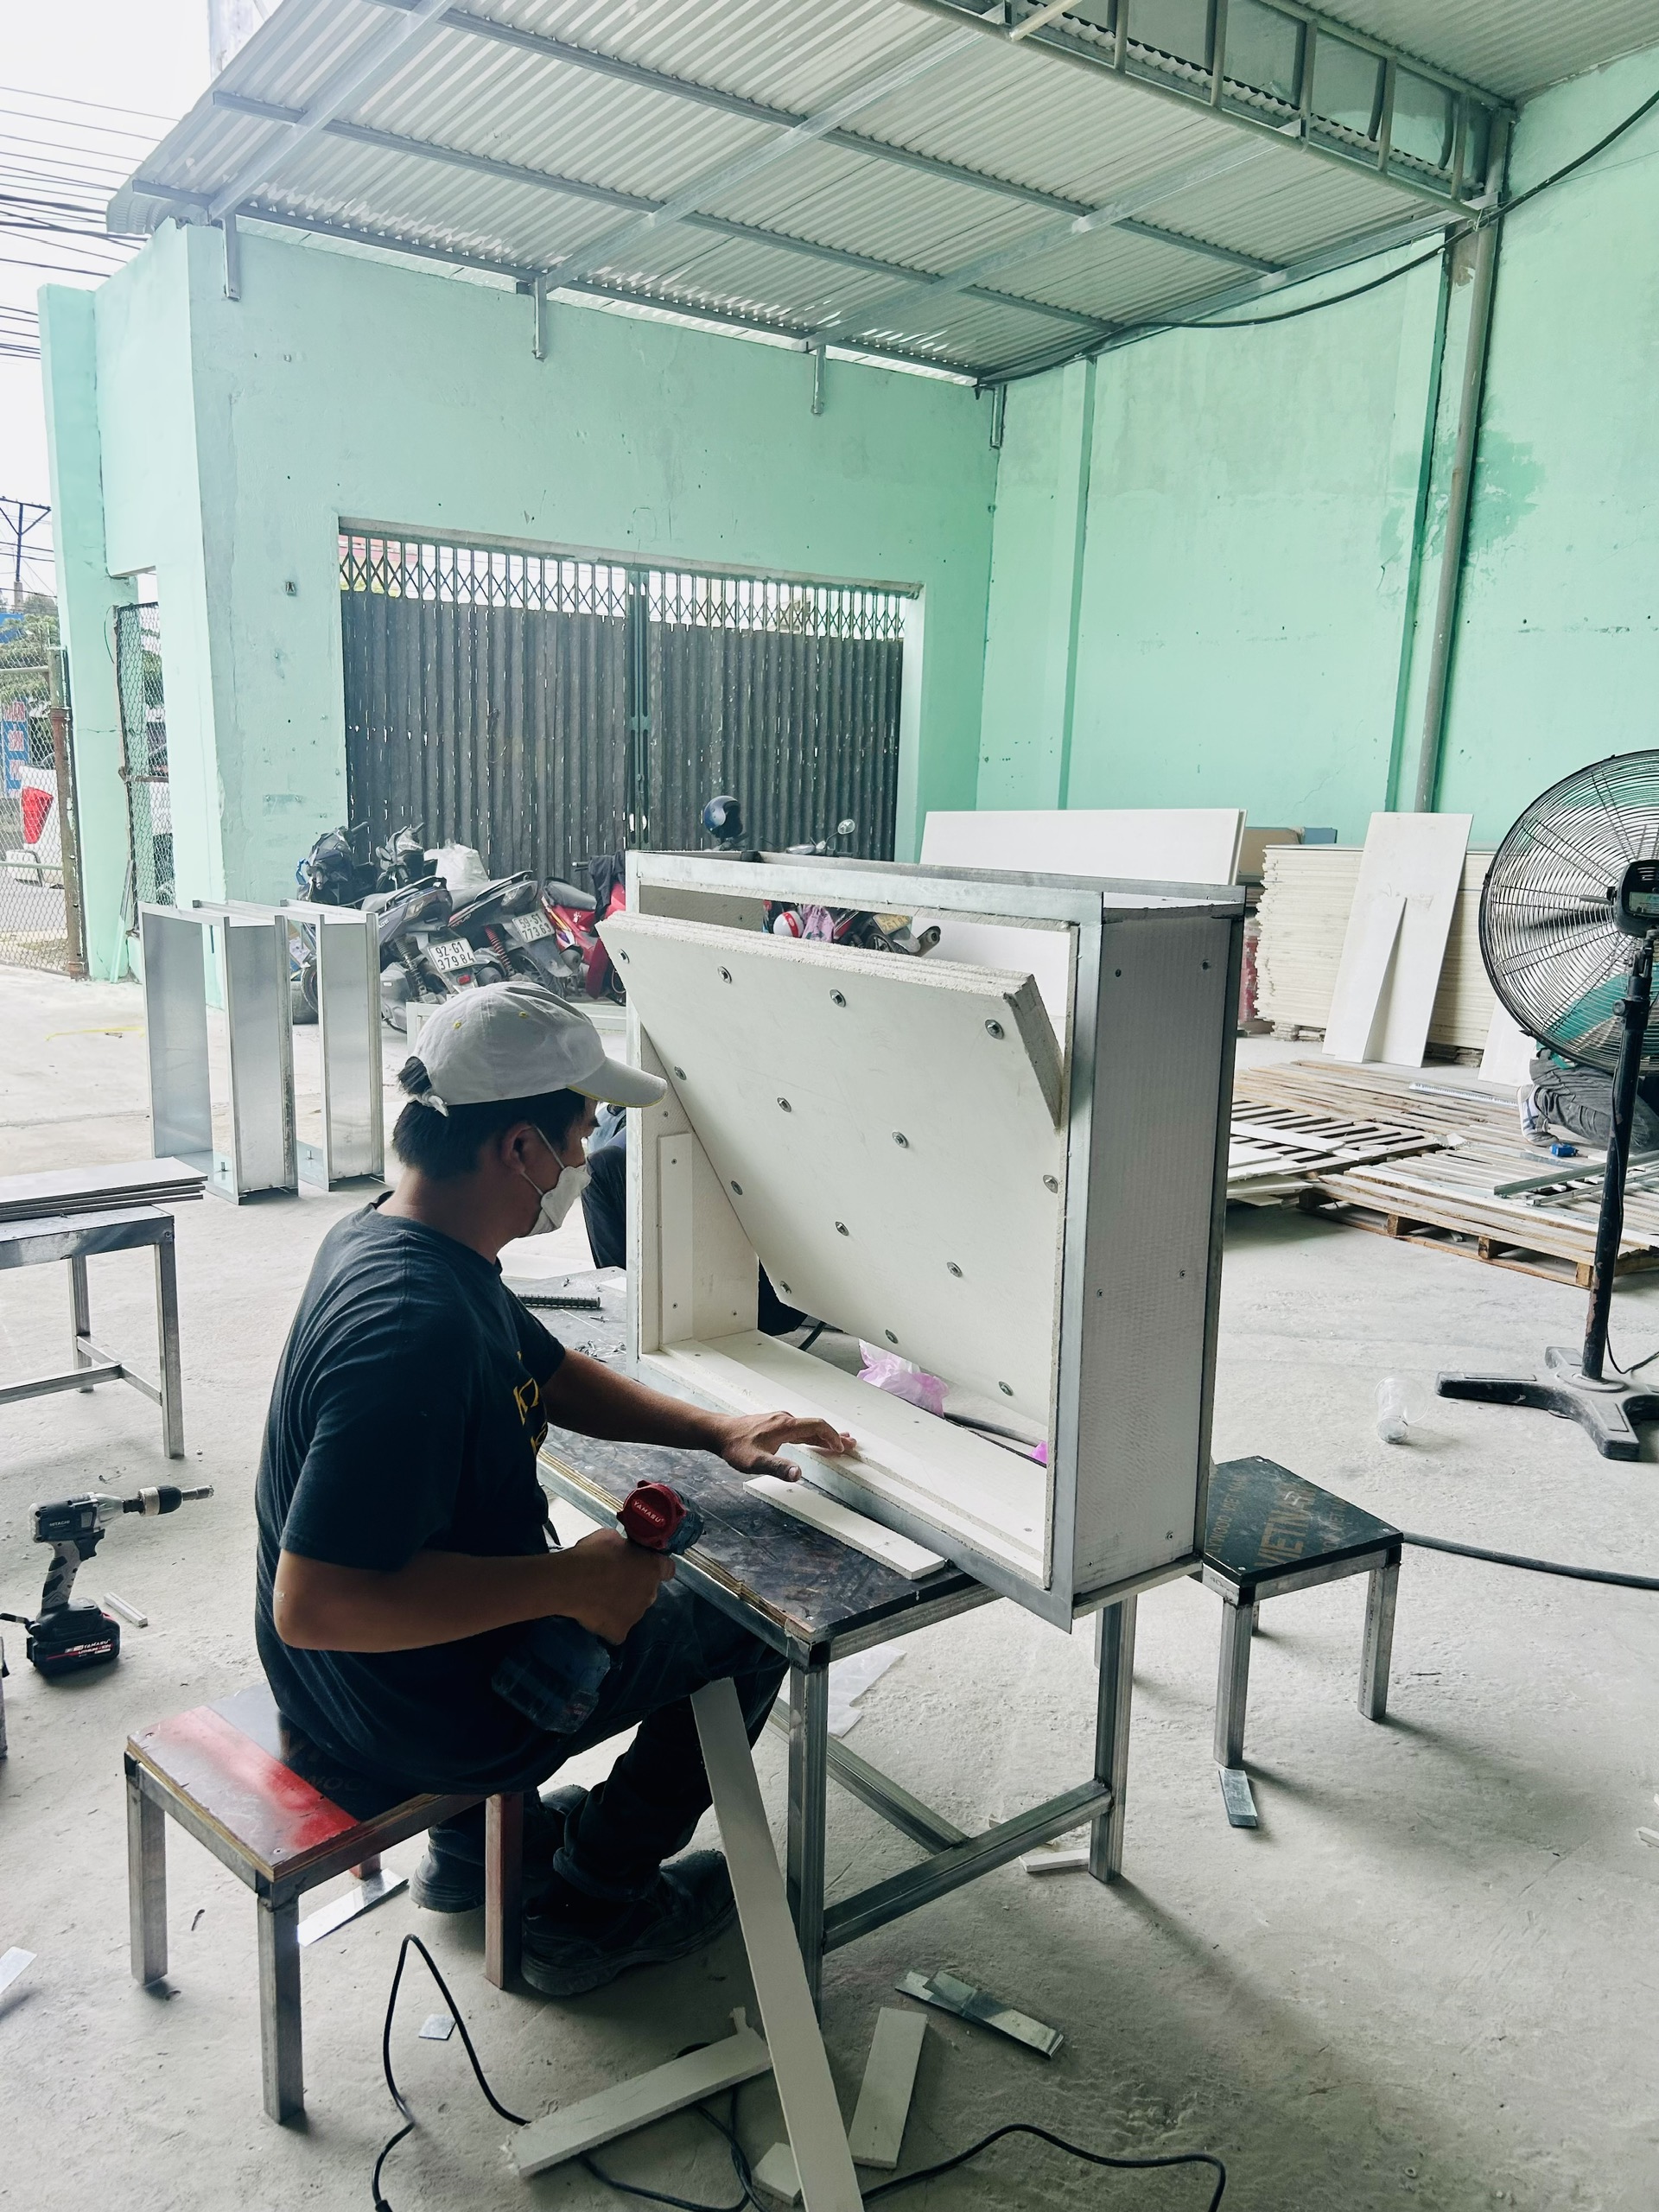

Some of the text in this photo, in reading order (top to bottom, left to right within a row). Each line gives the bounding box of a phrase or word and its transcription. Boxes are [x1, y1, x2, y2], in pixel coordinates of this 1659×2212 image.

[518, 913, 543, 929] 59-S1
[522, 922, 552, 941] 773.63
[435, 941, 465, 957] 92-G1
[437, 952, 474, 970] 379.84
